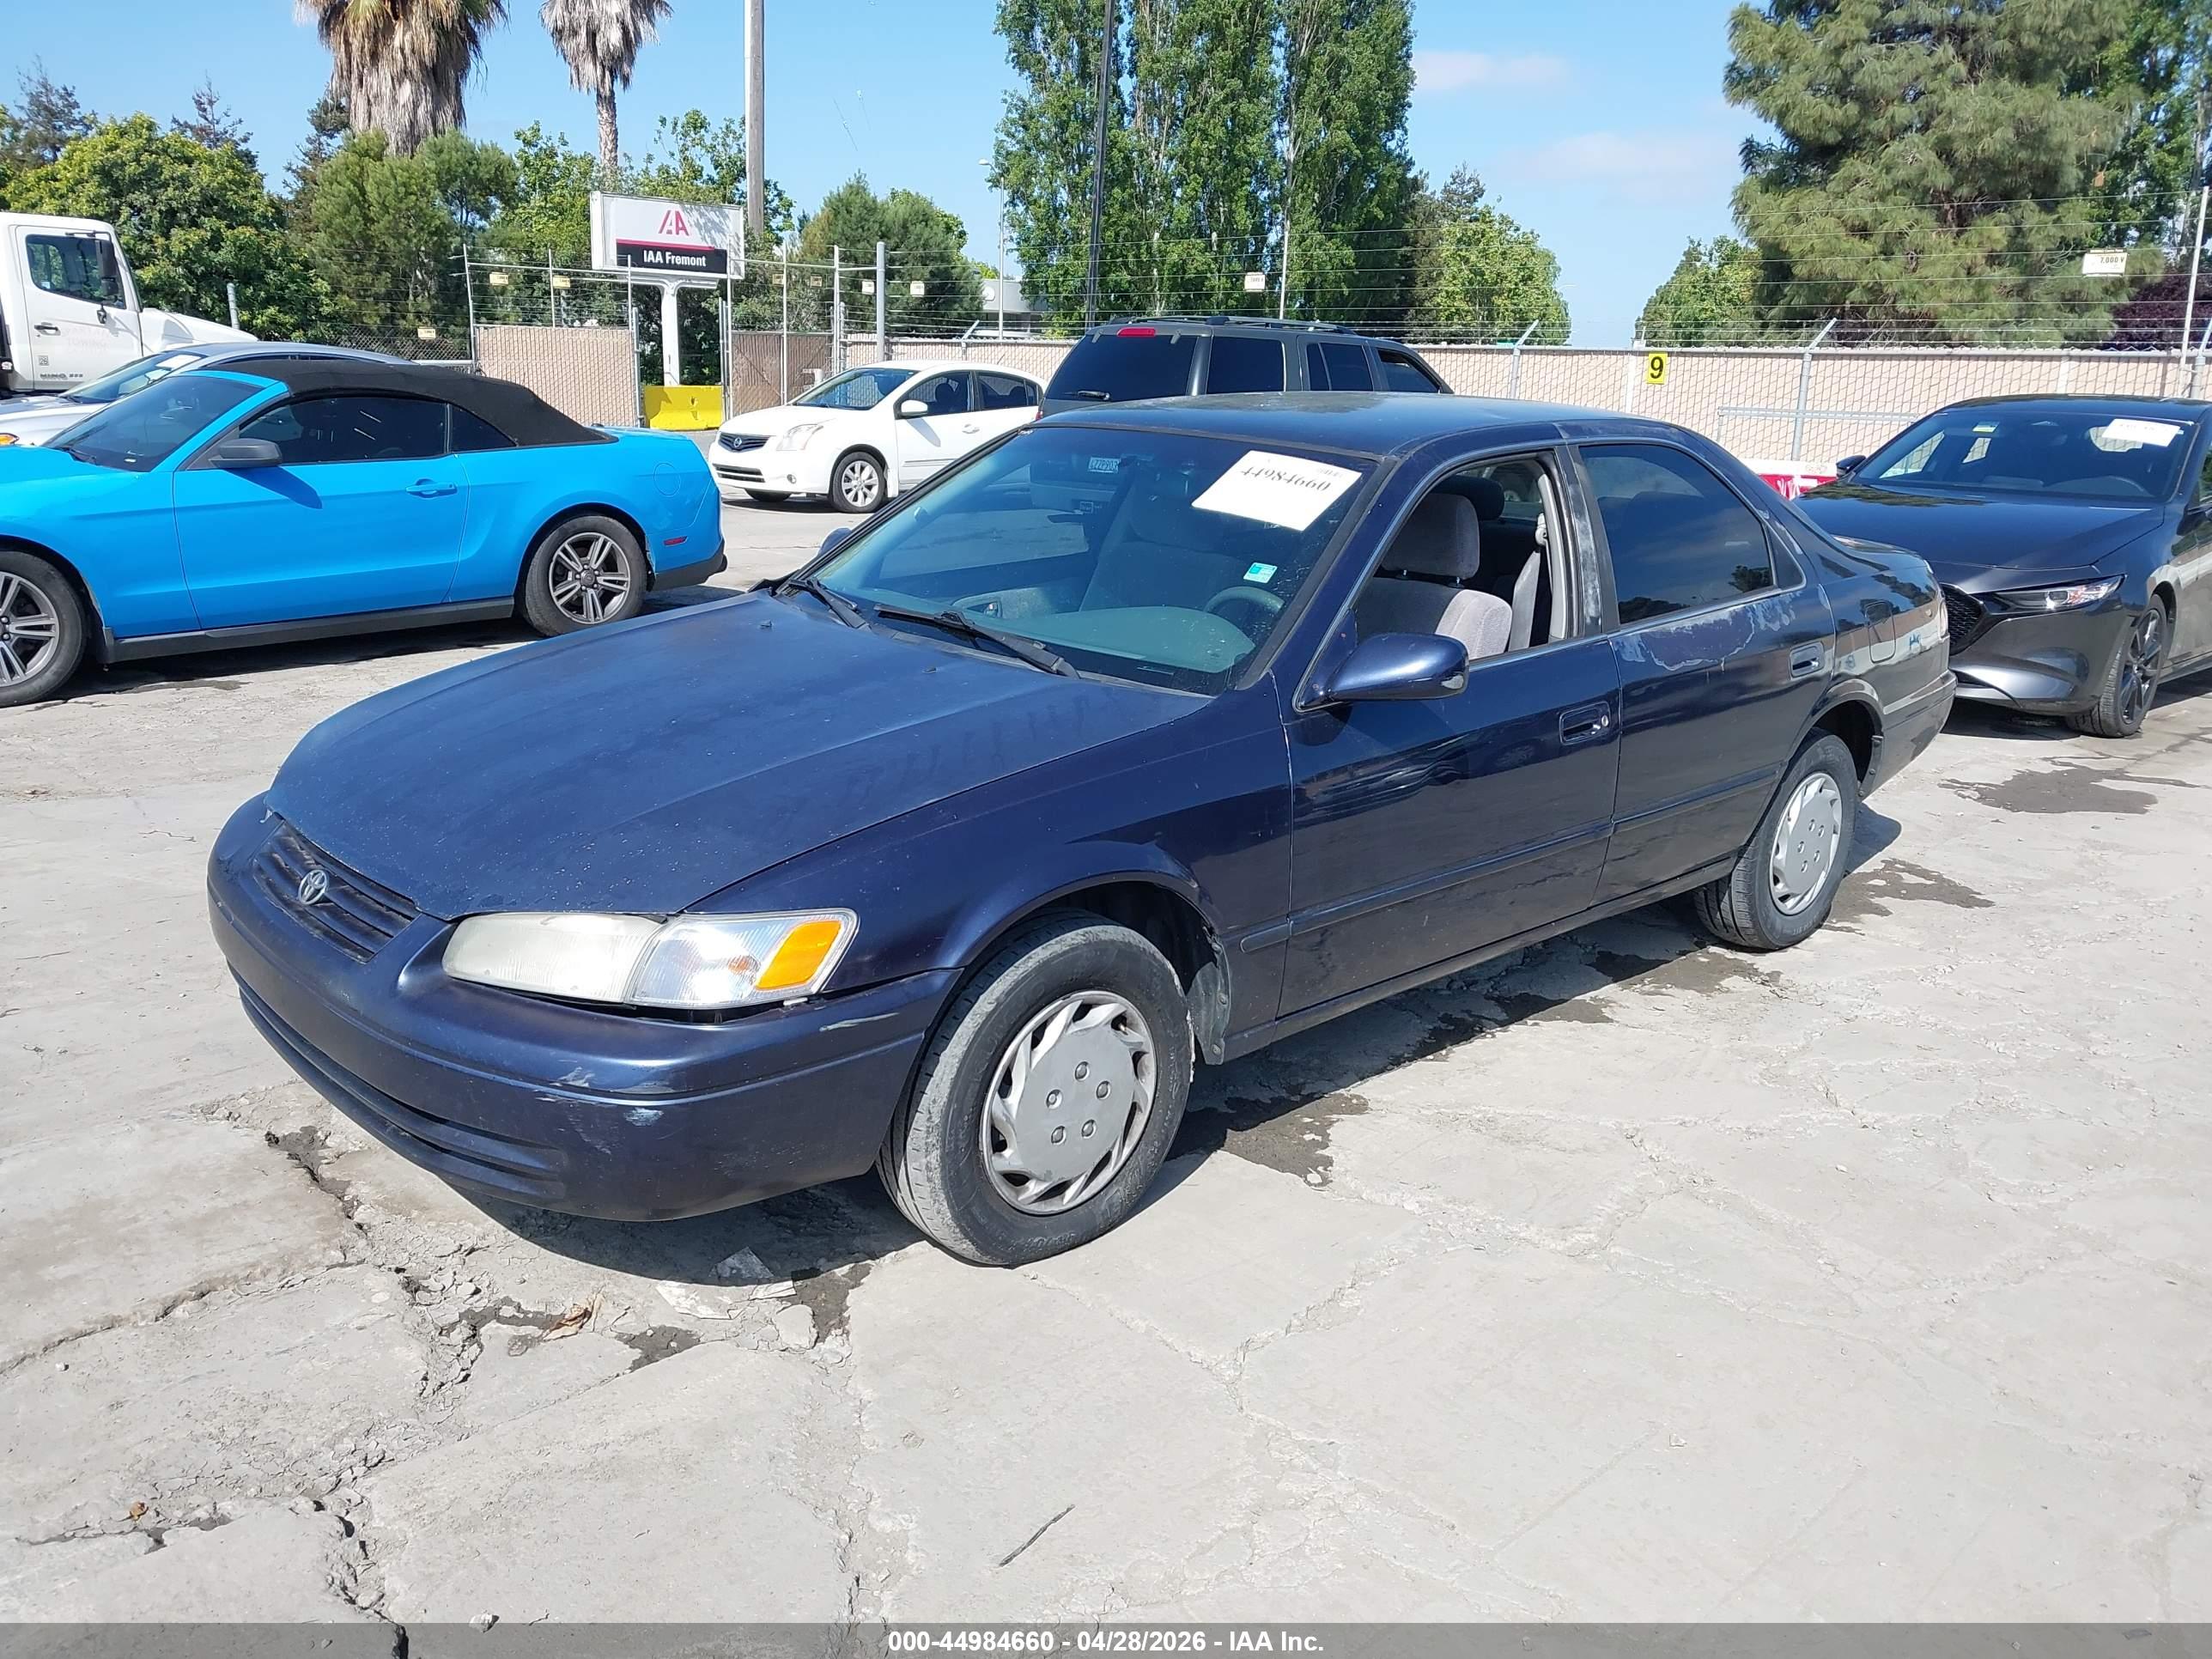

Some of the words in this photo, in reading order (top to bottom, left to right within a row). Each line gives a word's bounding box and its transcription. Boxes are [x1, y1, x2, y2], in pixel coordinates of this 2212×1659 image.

[643, 249, 664, 264] IAA
[665, 251, 707, 267] Fremont
[1650, 356, 1664, 380] 9
[1240, 466, 1332, 491] 44984660
